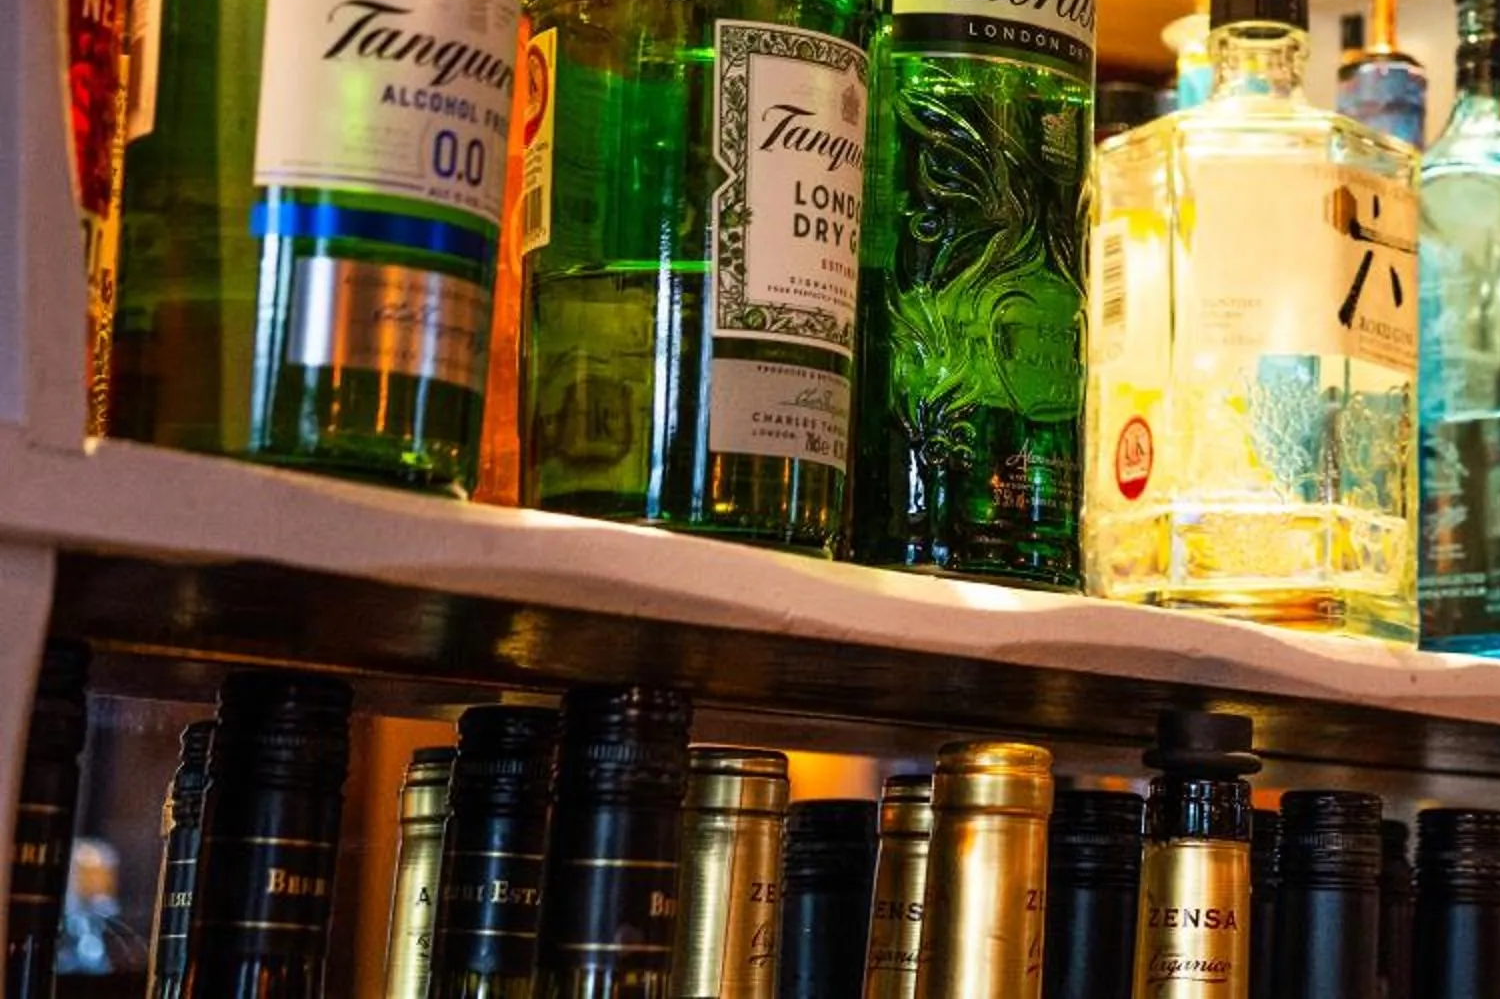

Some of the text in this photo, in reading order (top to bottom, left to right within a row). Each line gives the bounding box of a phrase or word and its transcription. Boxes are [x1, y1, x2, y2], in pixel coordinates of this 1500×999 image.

[969, 22, 1060, 51] LONDON
[381, 85, 478, 123] ALCOHOL
[433, 129, 485, 187] 0.0
[793, 212, 845, 247] DRY
[752, 412, 817, 431] CHARLES
[750, 882, 776, 904] ZE
[1147, 907, 1239, 931] ZENSA
